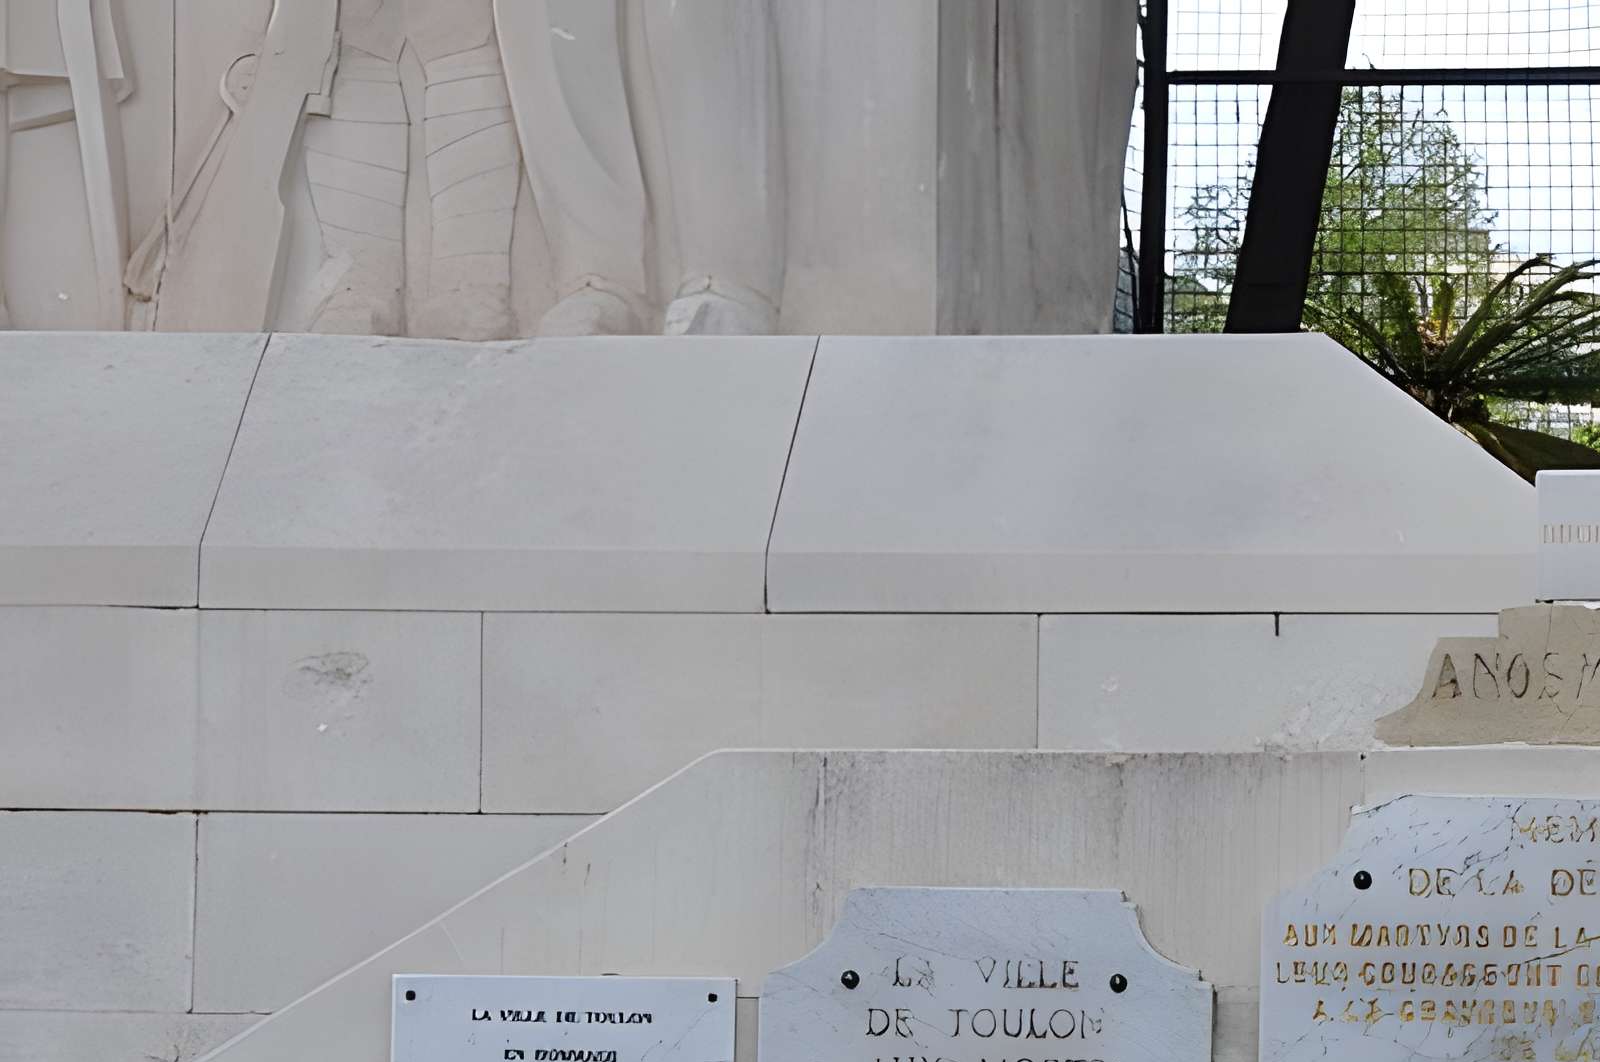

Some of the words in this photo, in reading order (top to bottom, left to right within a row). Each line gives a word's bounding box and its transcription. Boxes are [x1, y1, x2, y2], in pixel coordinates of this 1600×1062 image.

[975, 958, 1079, 989] VILLE
[866, 1007, 913, 1037] DE
[951, 1007, 1104, 1039] TOULON
